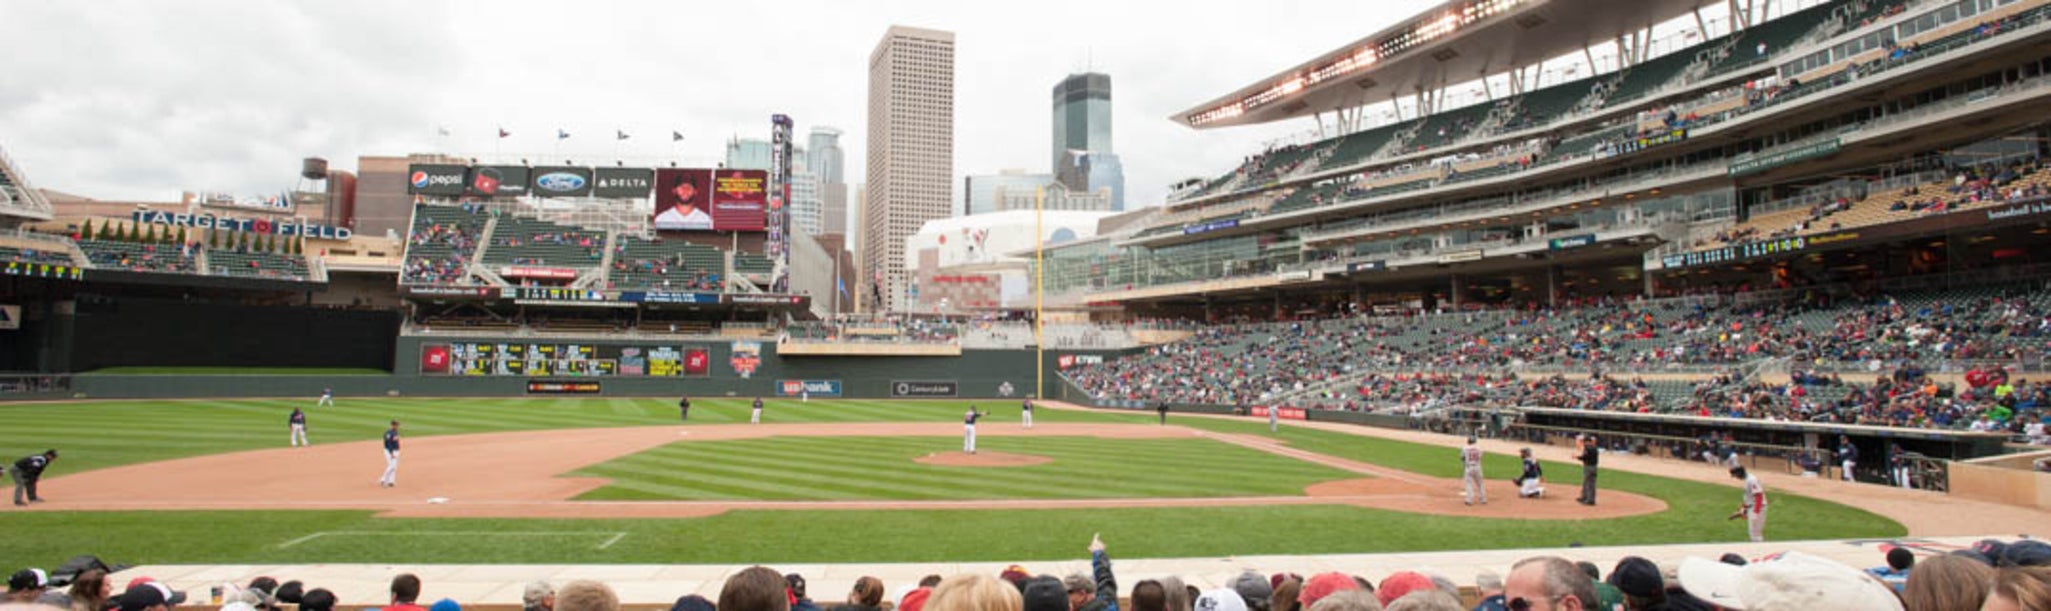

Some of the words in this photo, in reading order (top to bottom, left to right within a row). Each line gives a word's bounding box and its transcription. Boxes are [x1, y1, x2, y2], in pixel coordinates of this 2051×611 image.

[429, 170, 463, 186] pepsi
[610, 178, 648, 187] DELTA
[136, 210, 250, 233] TARGET
[277, 222, 352, 240] FIELD
